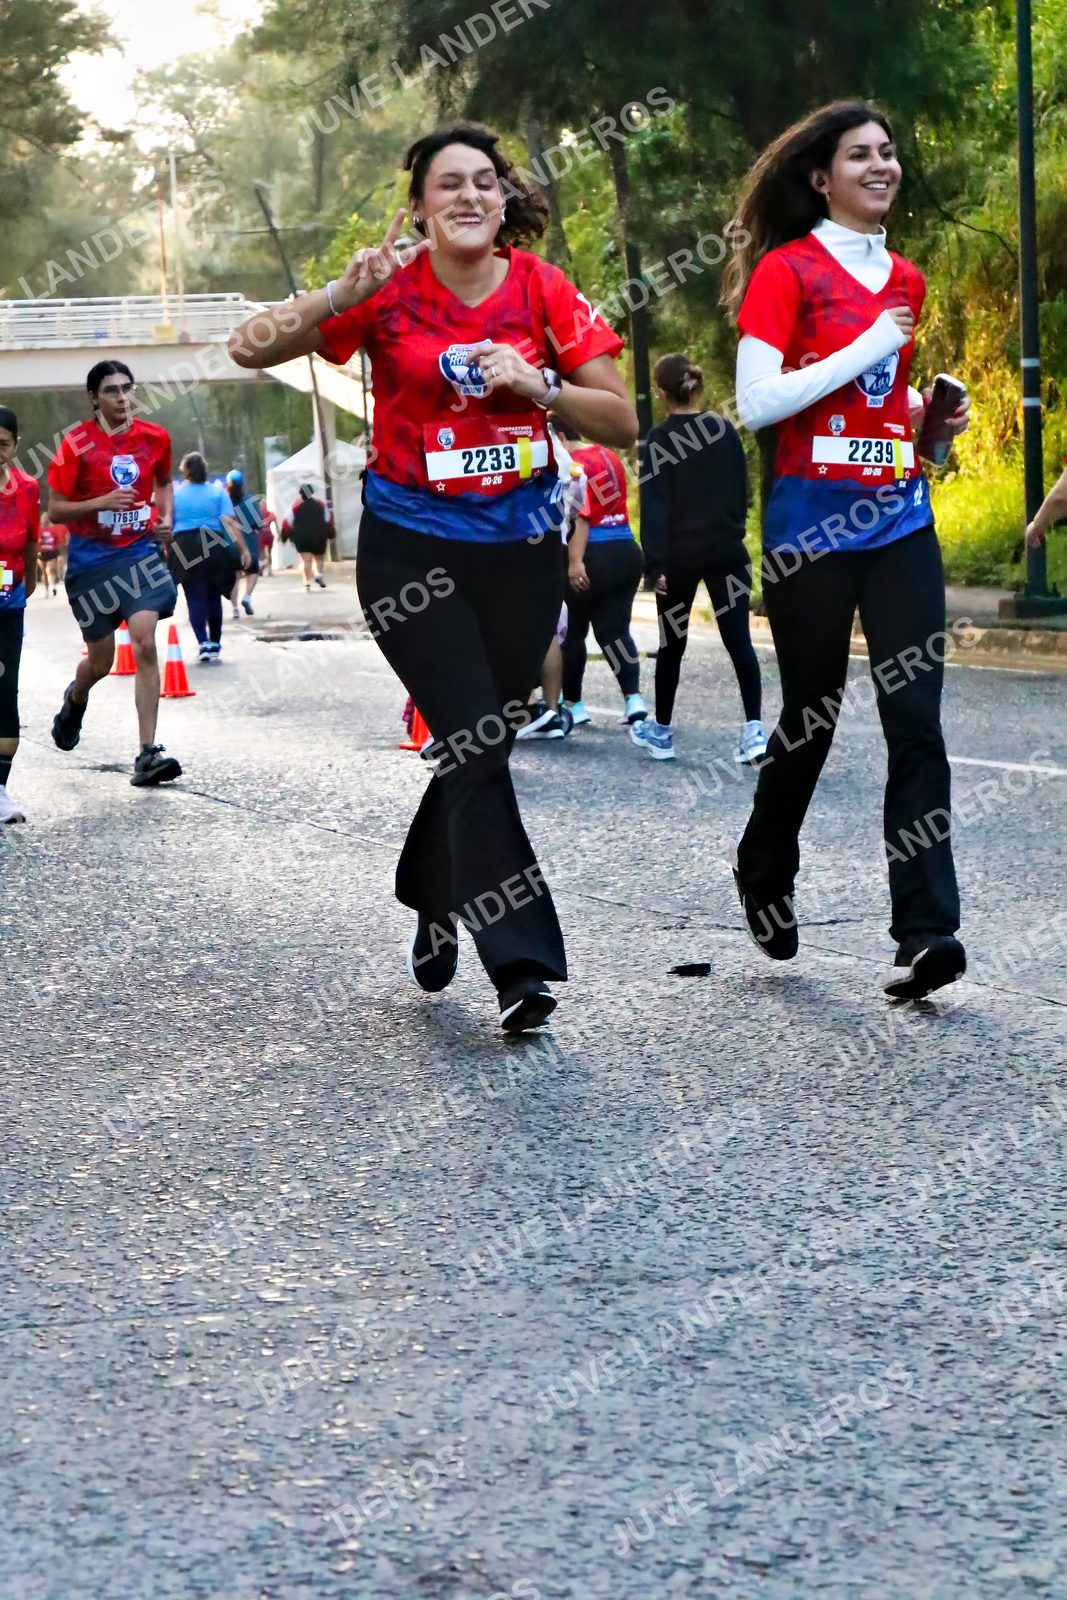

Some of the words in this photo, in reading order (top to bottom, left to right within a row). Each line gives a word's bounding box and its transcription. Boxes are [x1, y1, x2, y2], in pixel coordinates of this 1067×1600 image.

[462, 446, 516, 475] 2233
[848, 440, 894, 464] 2239
[113, 511, 139, 523] 17630
